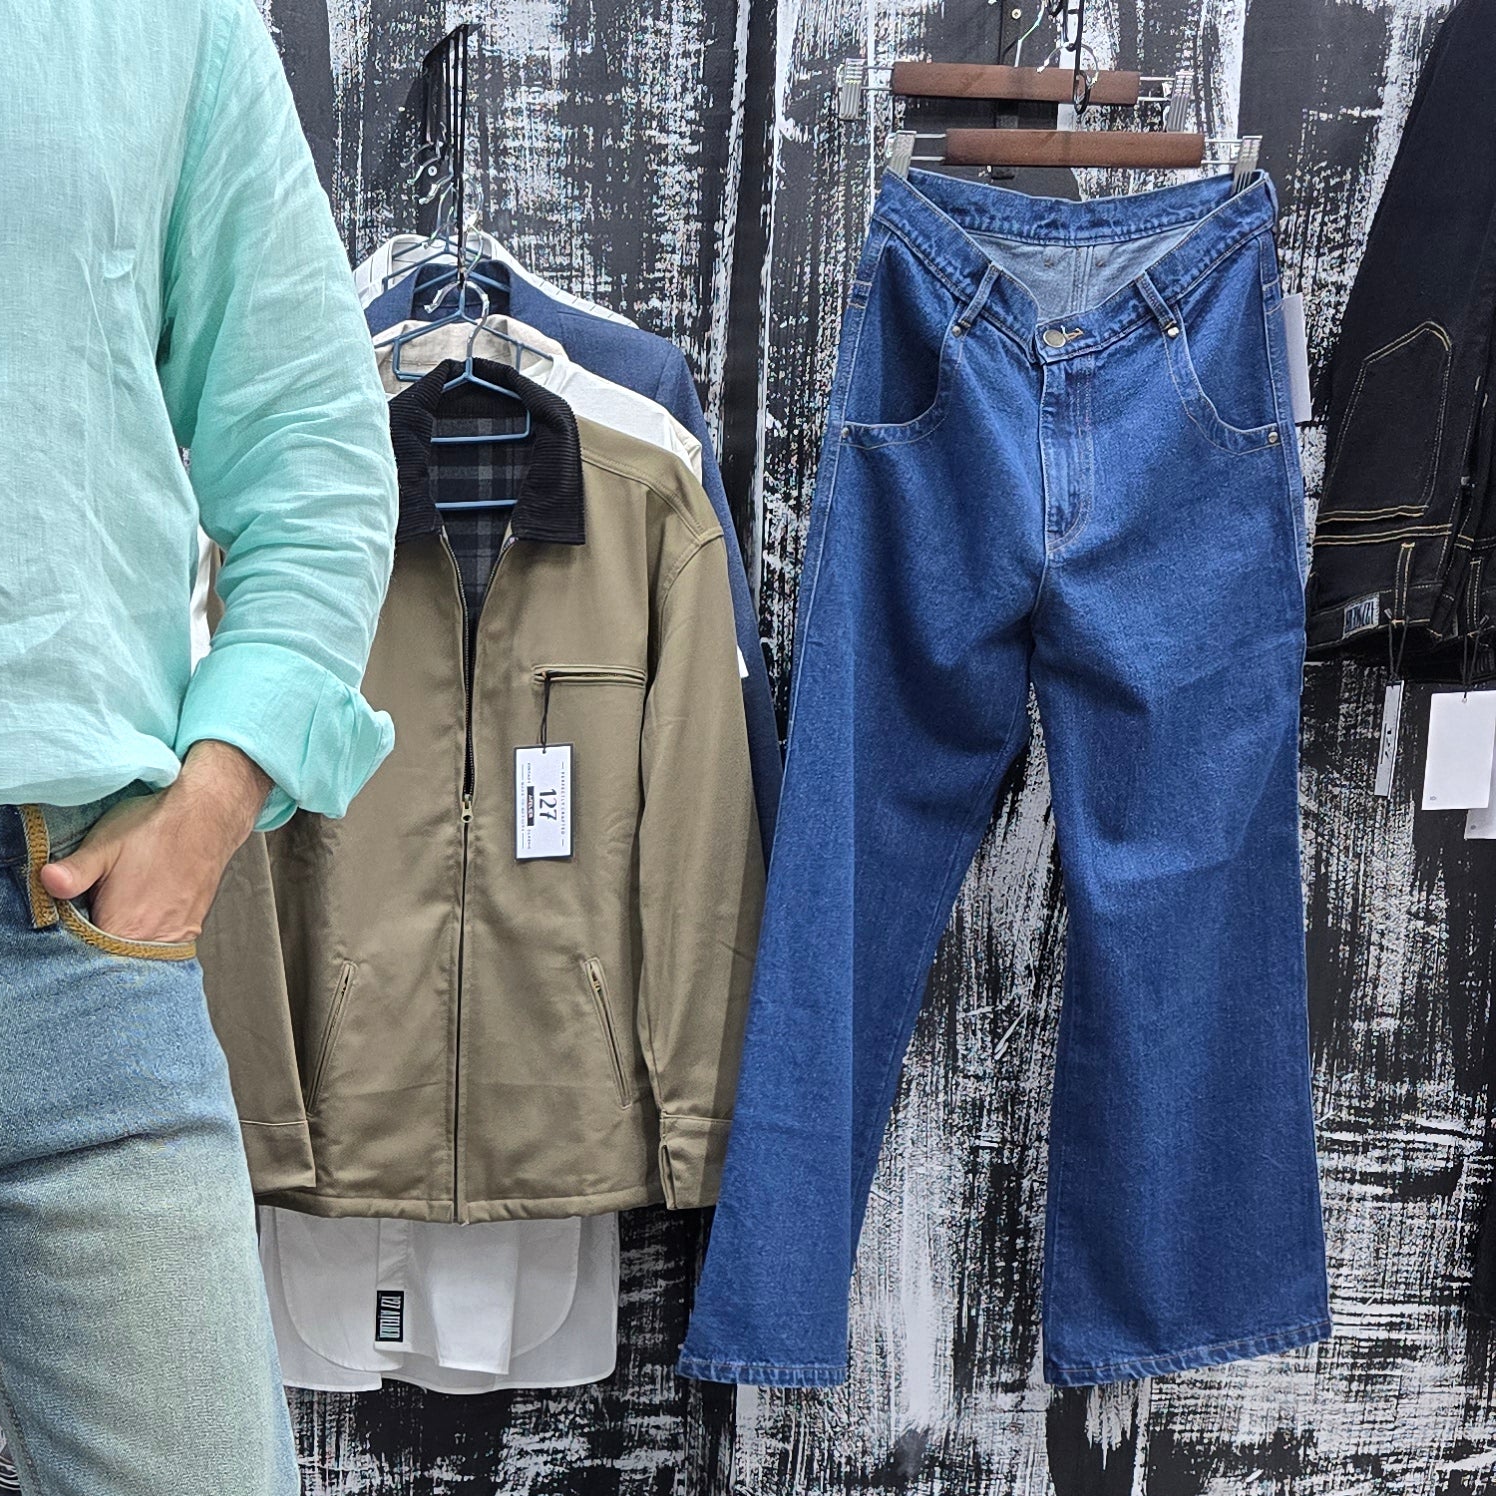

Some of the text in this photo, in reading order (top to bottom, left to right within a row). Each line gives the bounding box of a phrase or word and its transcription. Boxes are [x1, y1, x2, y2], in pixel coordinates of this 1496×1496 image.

[539, 788, 557, 821] 127
[380, 1295, 401, 1338] 127 ATELIER
